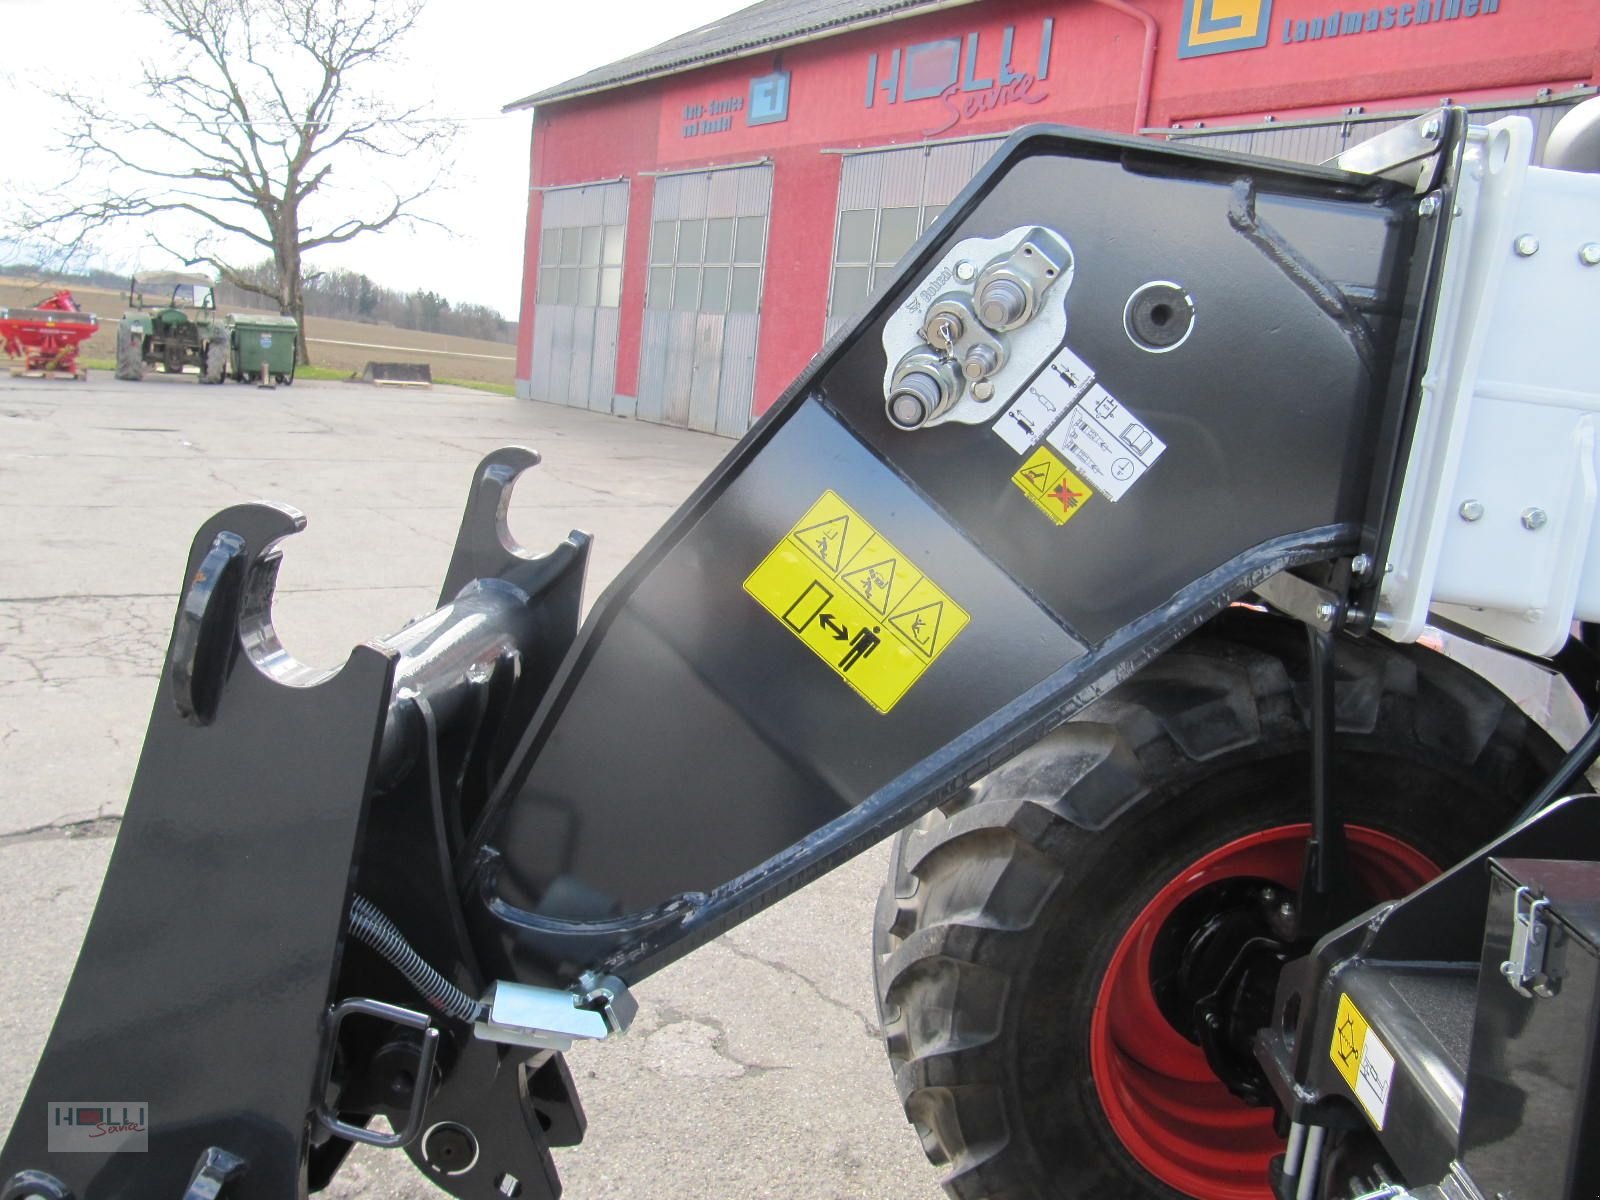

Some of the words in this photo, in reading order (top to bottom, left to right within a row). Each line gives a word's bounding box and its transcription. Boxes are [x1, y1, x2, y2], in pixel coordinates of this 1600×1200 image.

[1282, 0, 1497, 44] Landmaschinen
[864, 16, 1054, 109] HOLLI
[922, 72, 1049, 137] Service
